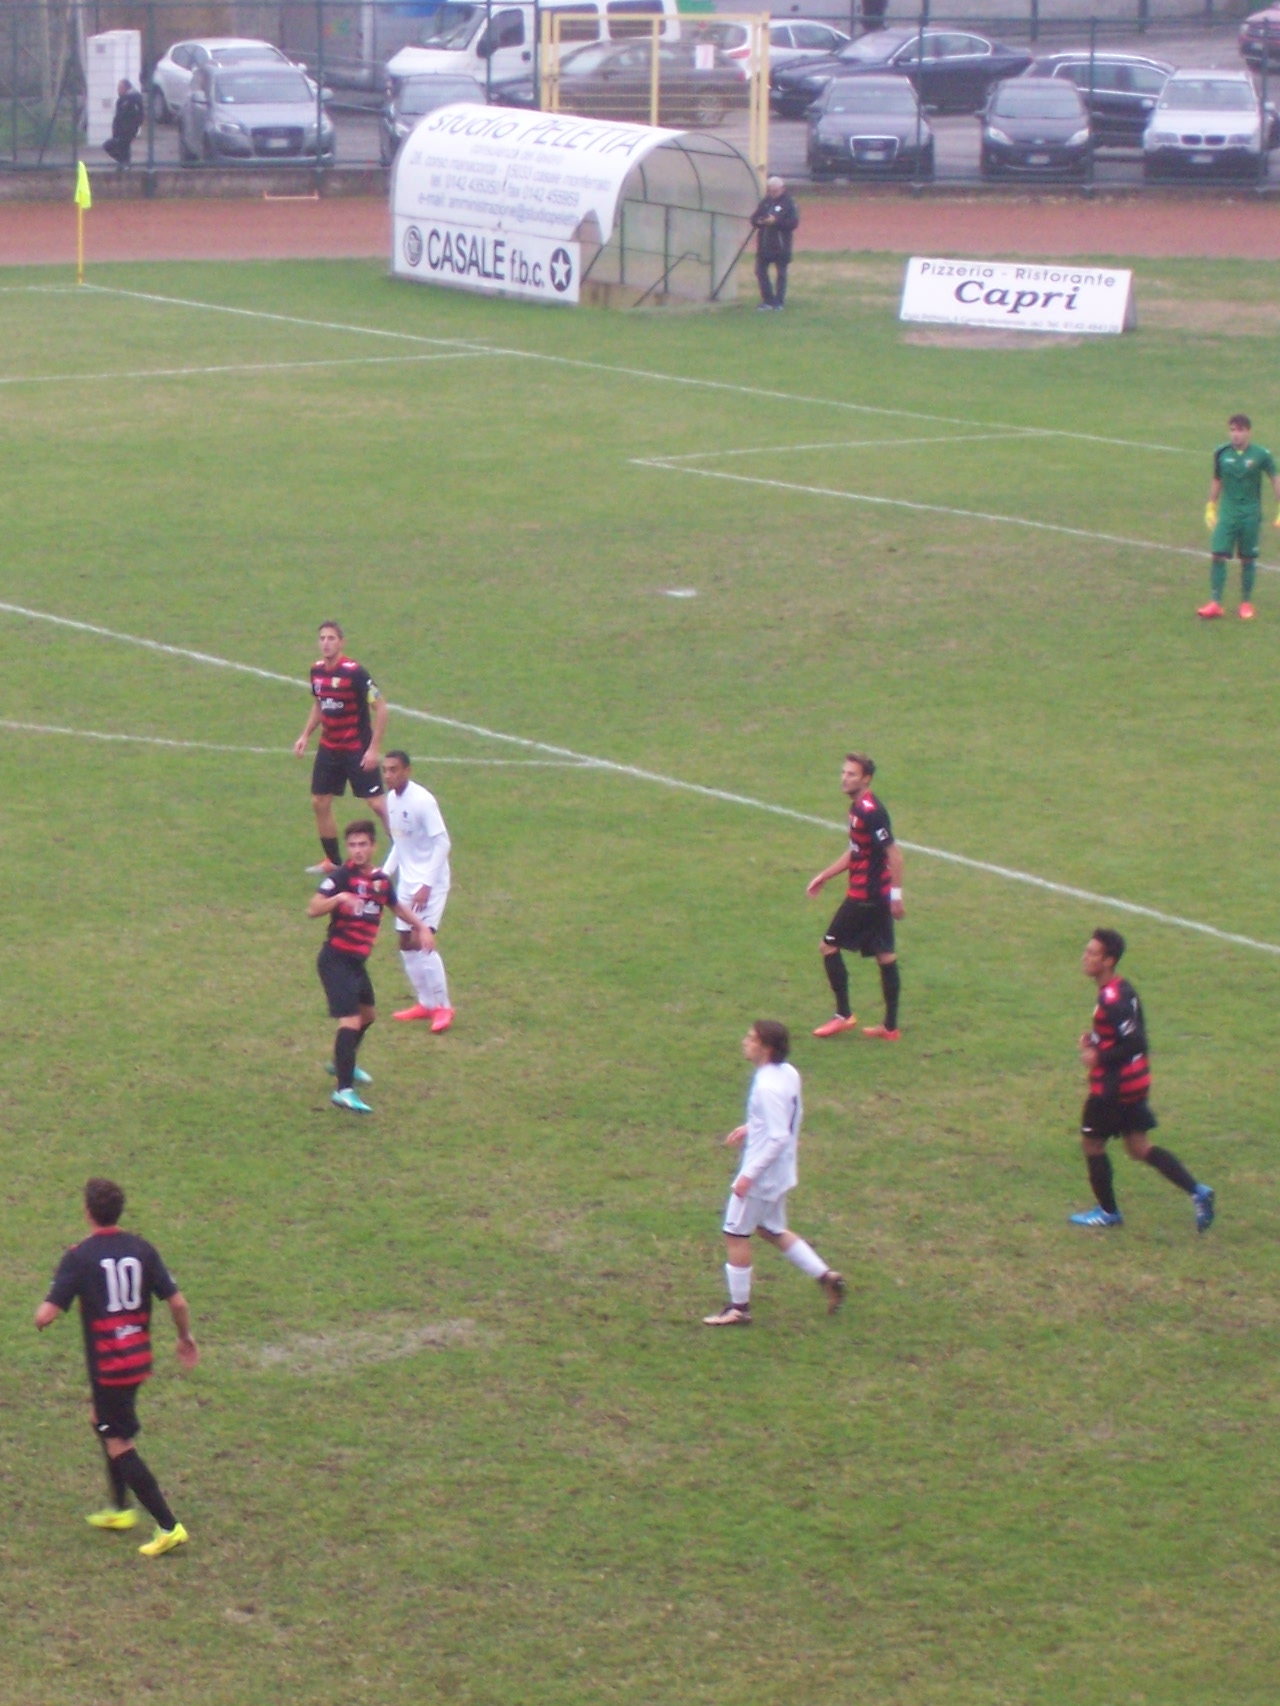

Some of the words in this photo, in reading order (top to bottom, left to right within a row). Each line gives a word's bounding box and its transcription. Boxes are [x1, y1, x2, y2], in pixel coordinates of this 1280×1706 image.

[427, 228, 506, 279] CASALE
[510, 249, 545, 288] f.b.c.
[921, 262, 994, 279] Pizzeria
[1015, 268, 1116, 287] Ristorante
[954, 280, 1080, 314] Capri
[100, 1256, 144, 1312] 10
